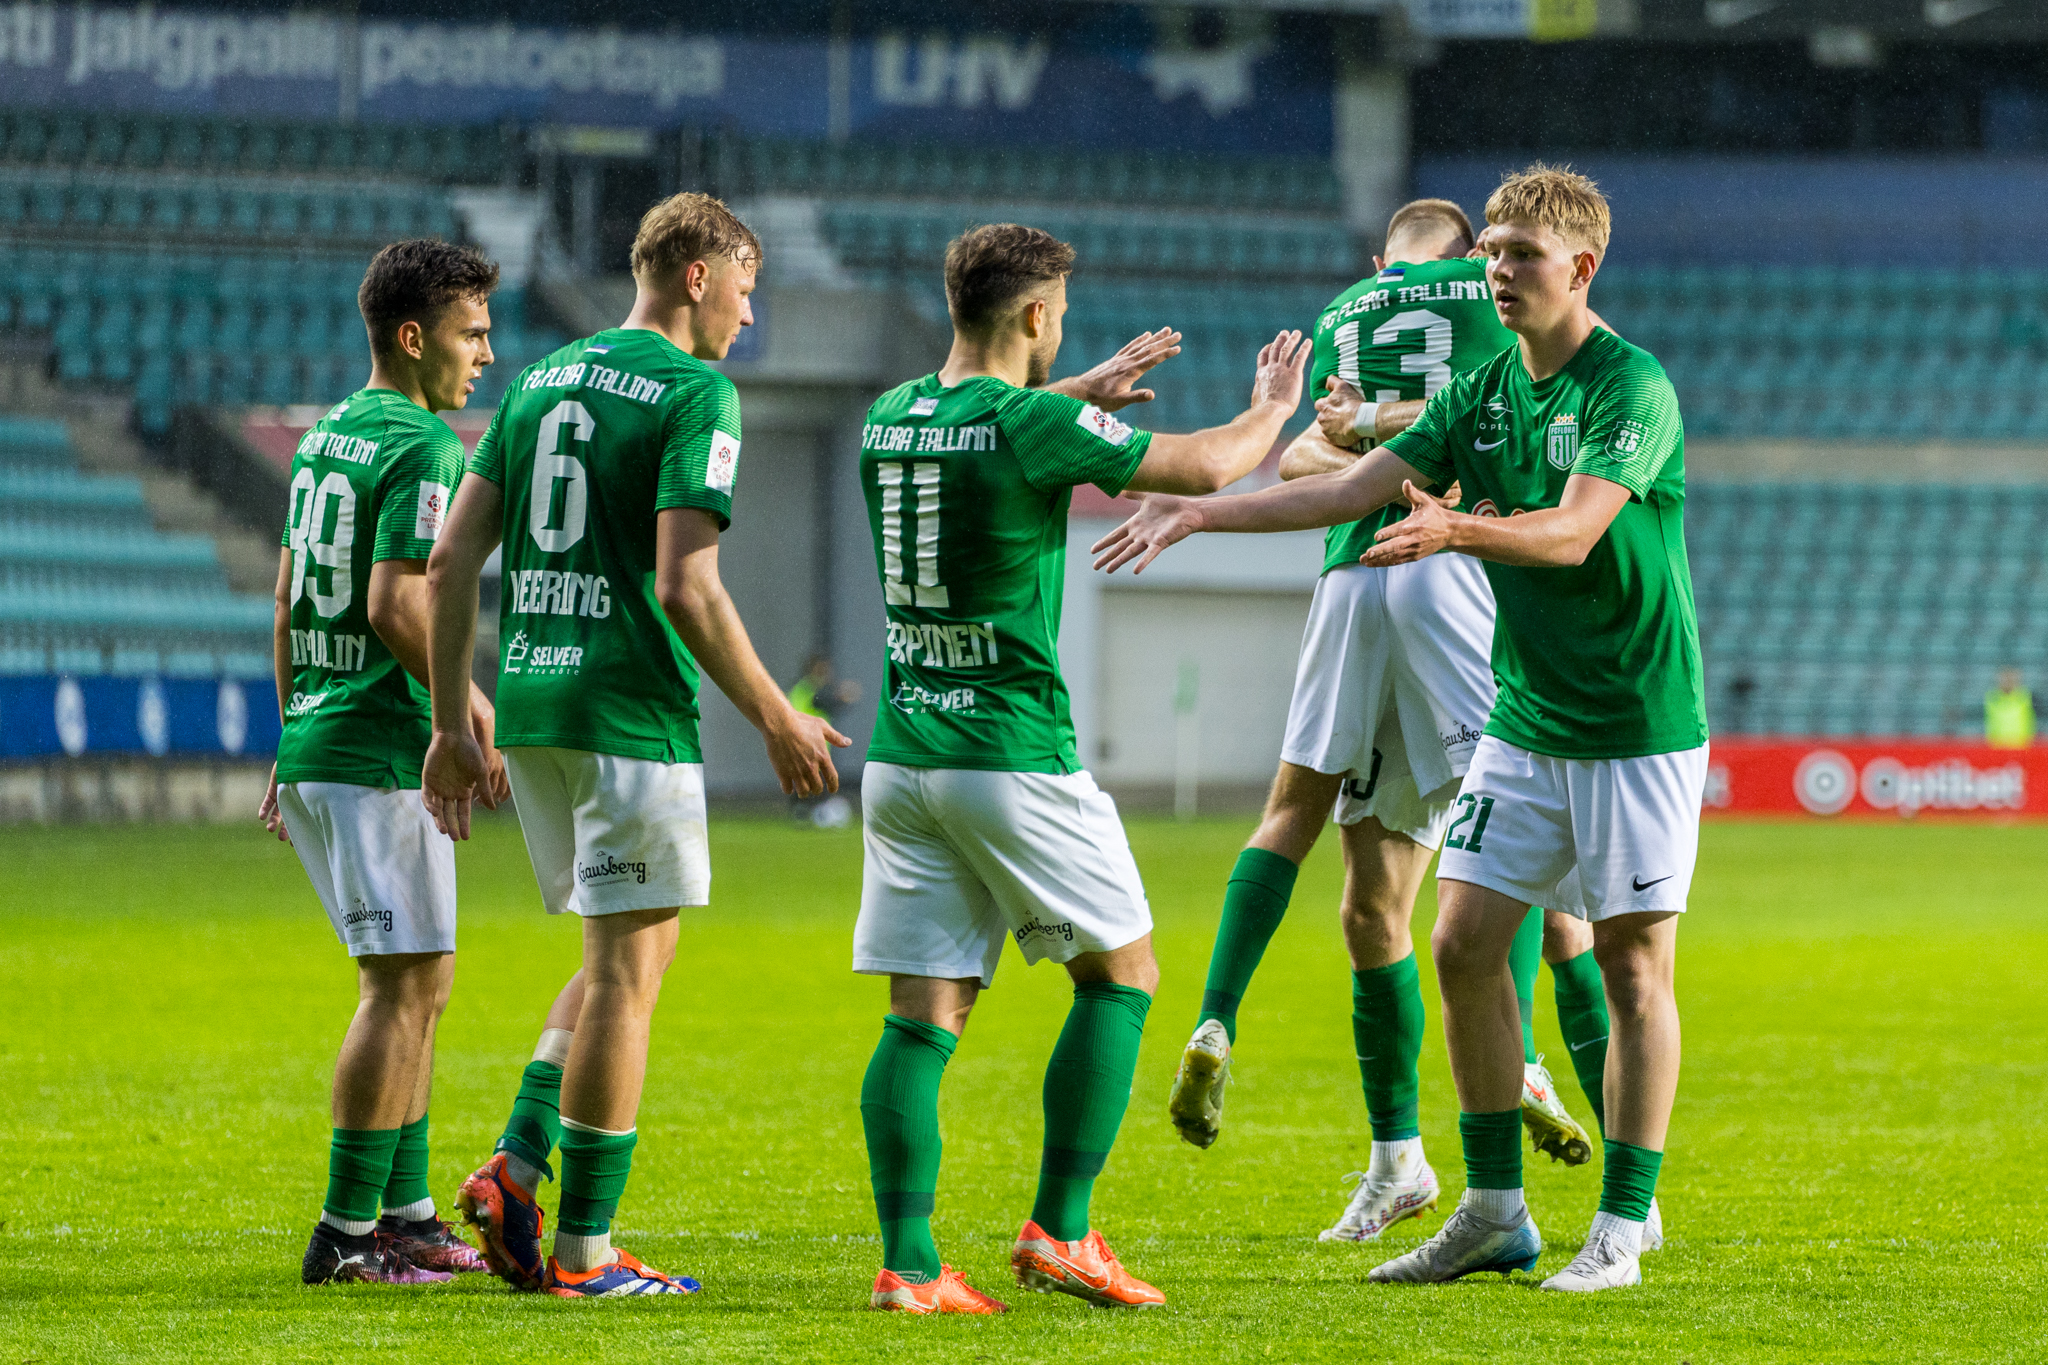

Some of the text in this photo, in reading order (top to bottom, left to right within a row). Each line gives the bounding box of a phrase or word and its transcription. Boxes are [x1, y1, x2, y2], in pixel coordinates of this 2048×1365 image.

[874, 35, 1050, 110] LHV
[1318, 280, 1489, 335] FC FLORA TALLINN
[520, 362, 666, 404] FC FLORA TALLINN
[1333, 309, 1453, 404] 13
[324, 432, 380, 466] TALLINN
[866, 424, 915, 452] FLORA
[916, 425, 996, 452] TALLINN
[1478, 422, 1511, 431] OPEL
[1614, 429, 1640, 452] 35
[529, 400, 596, 553] 6
[290, 467, 357, 619] 89
[878, 462, 950, 608] 11
[530, 646, 583, 666] SELVER
[1445, 792, 1495, 854] 21
